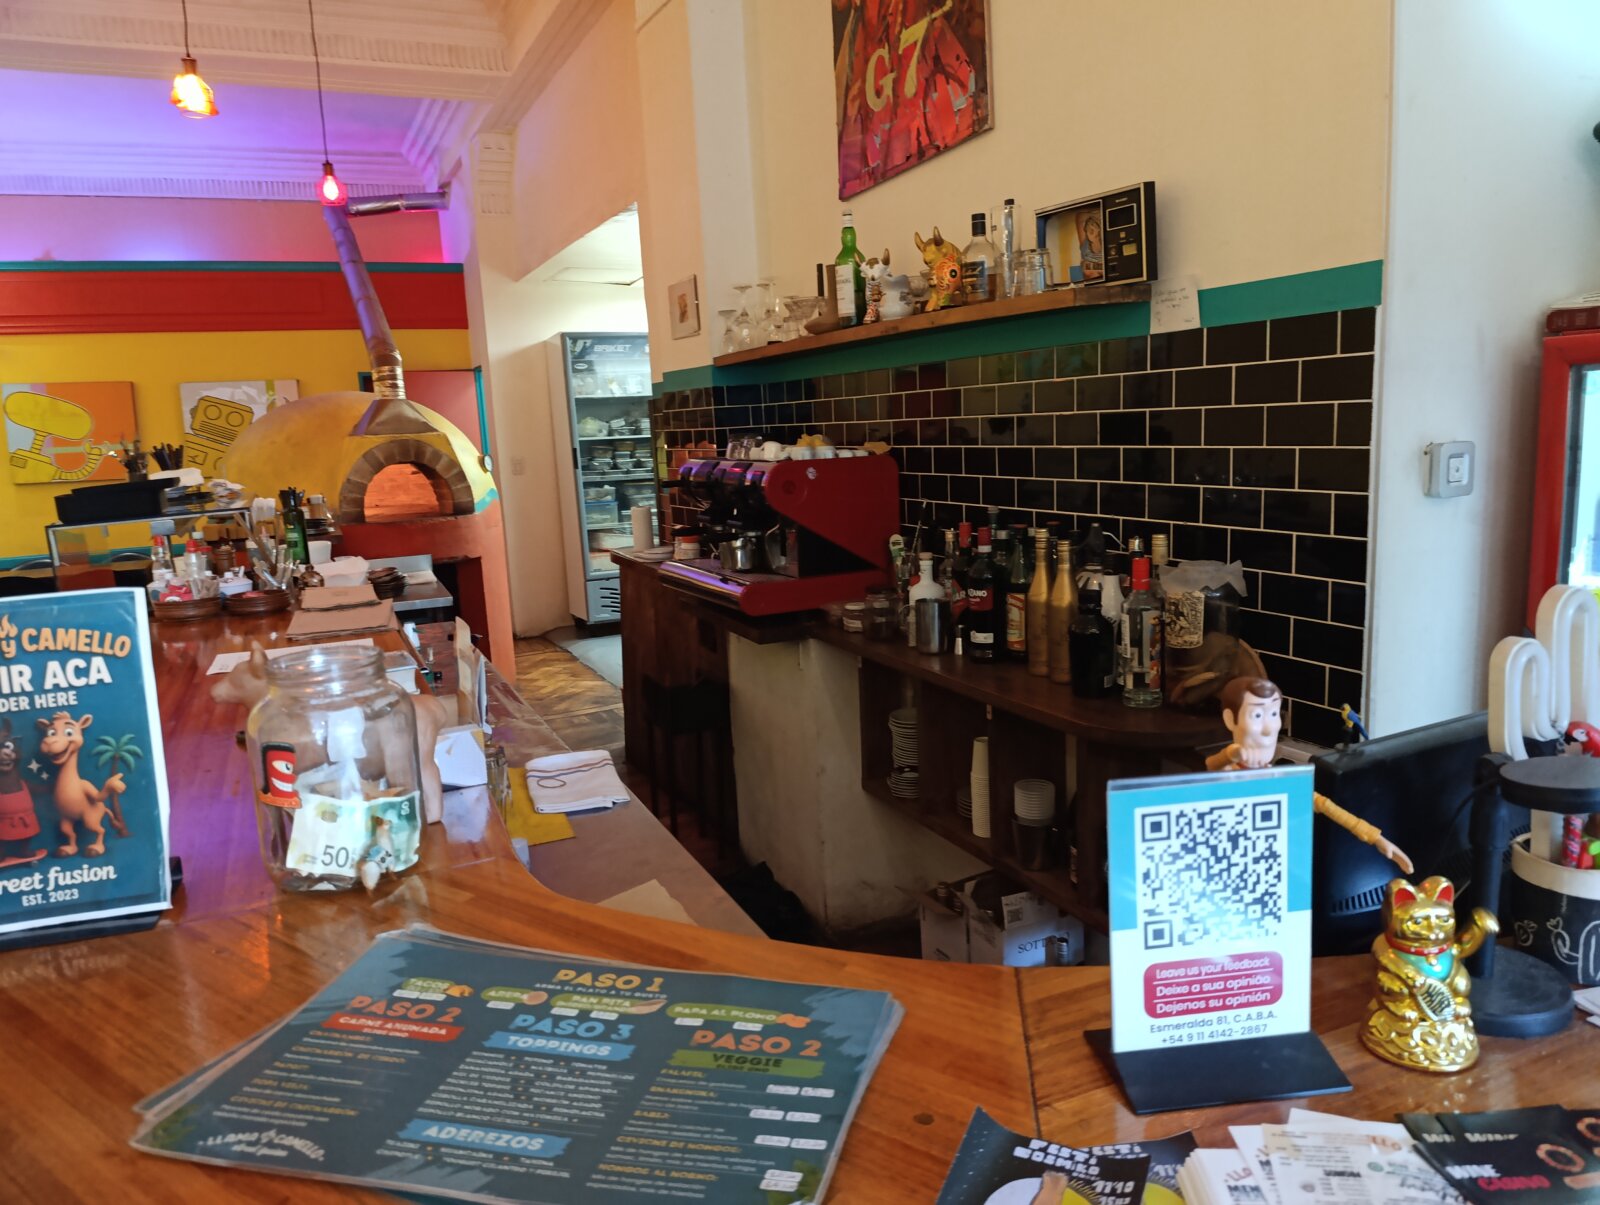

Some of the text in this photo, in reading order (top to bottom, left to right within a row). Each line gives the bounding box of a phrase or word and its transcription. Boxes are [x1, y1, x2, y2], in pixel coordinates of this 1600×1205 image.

[21, 627, 131, 657] CAMELLO
[44, 656, 113, 690] ACA
[34, 690, 78, 709] HERE
[321, 844, 350, 868] 50
[46, 864, 118, 892] fusion
[21, 888, 79, 907] EST. 2023
[1155, 956, 1270, 980] Leave us your feedback
[552, 969, 665, 993] PASO 1
[1155, 984, 1189, 997] Deixe
[1191, 984, 1201, 993] a
[1201, 980, 1225, 992] sua
[349, 995, 463, 1023] PASO 2
[674, 1006, 708, 1016] PAPA
[1155, 991, 1271, 1014] Dejenos su opinión
[508, 1013, 635, 1041] PASO 3
[1149, 1010, 1278, 1034] Esmeralda 81, C.A.B.A.
[507, 1034, 612, 1057] TOPPINGS
[689, 1029, 822, 1057] PASO 2
[1161, 1034, 1184, 1045] +54
[1186, 1032, 1194, 1042] 9
[1196, 1031, 1205, 1041] 11
[712, 1053, 785, 1068] VEGGIE
[422, 1125, 546, 1151] ADEREZOS
